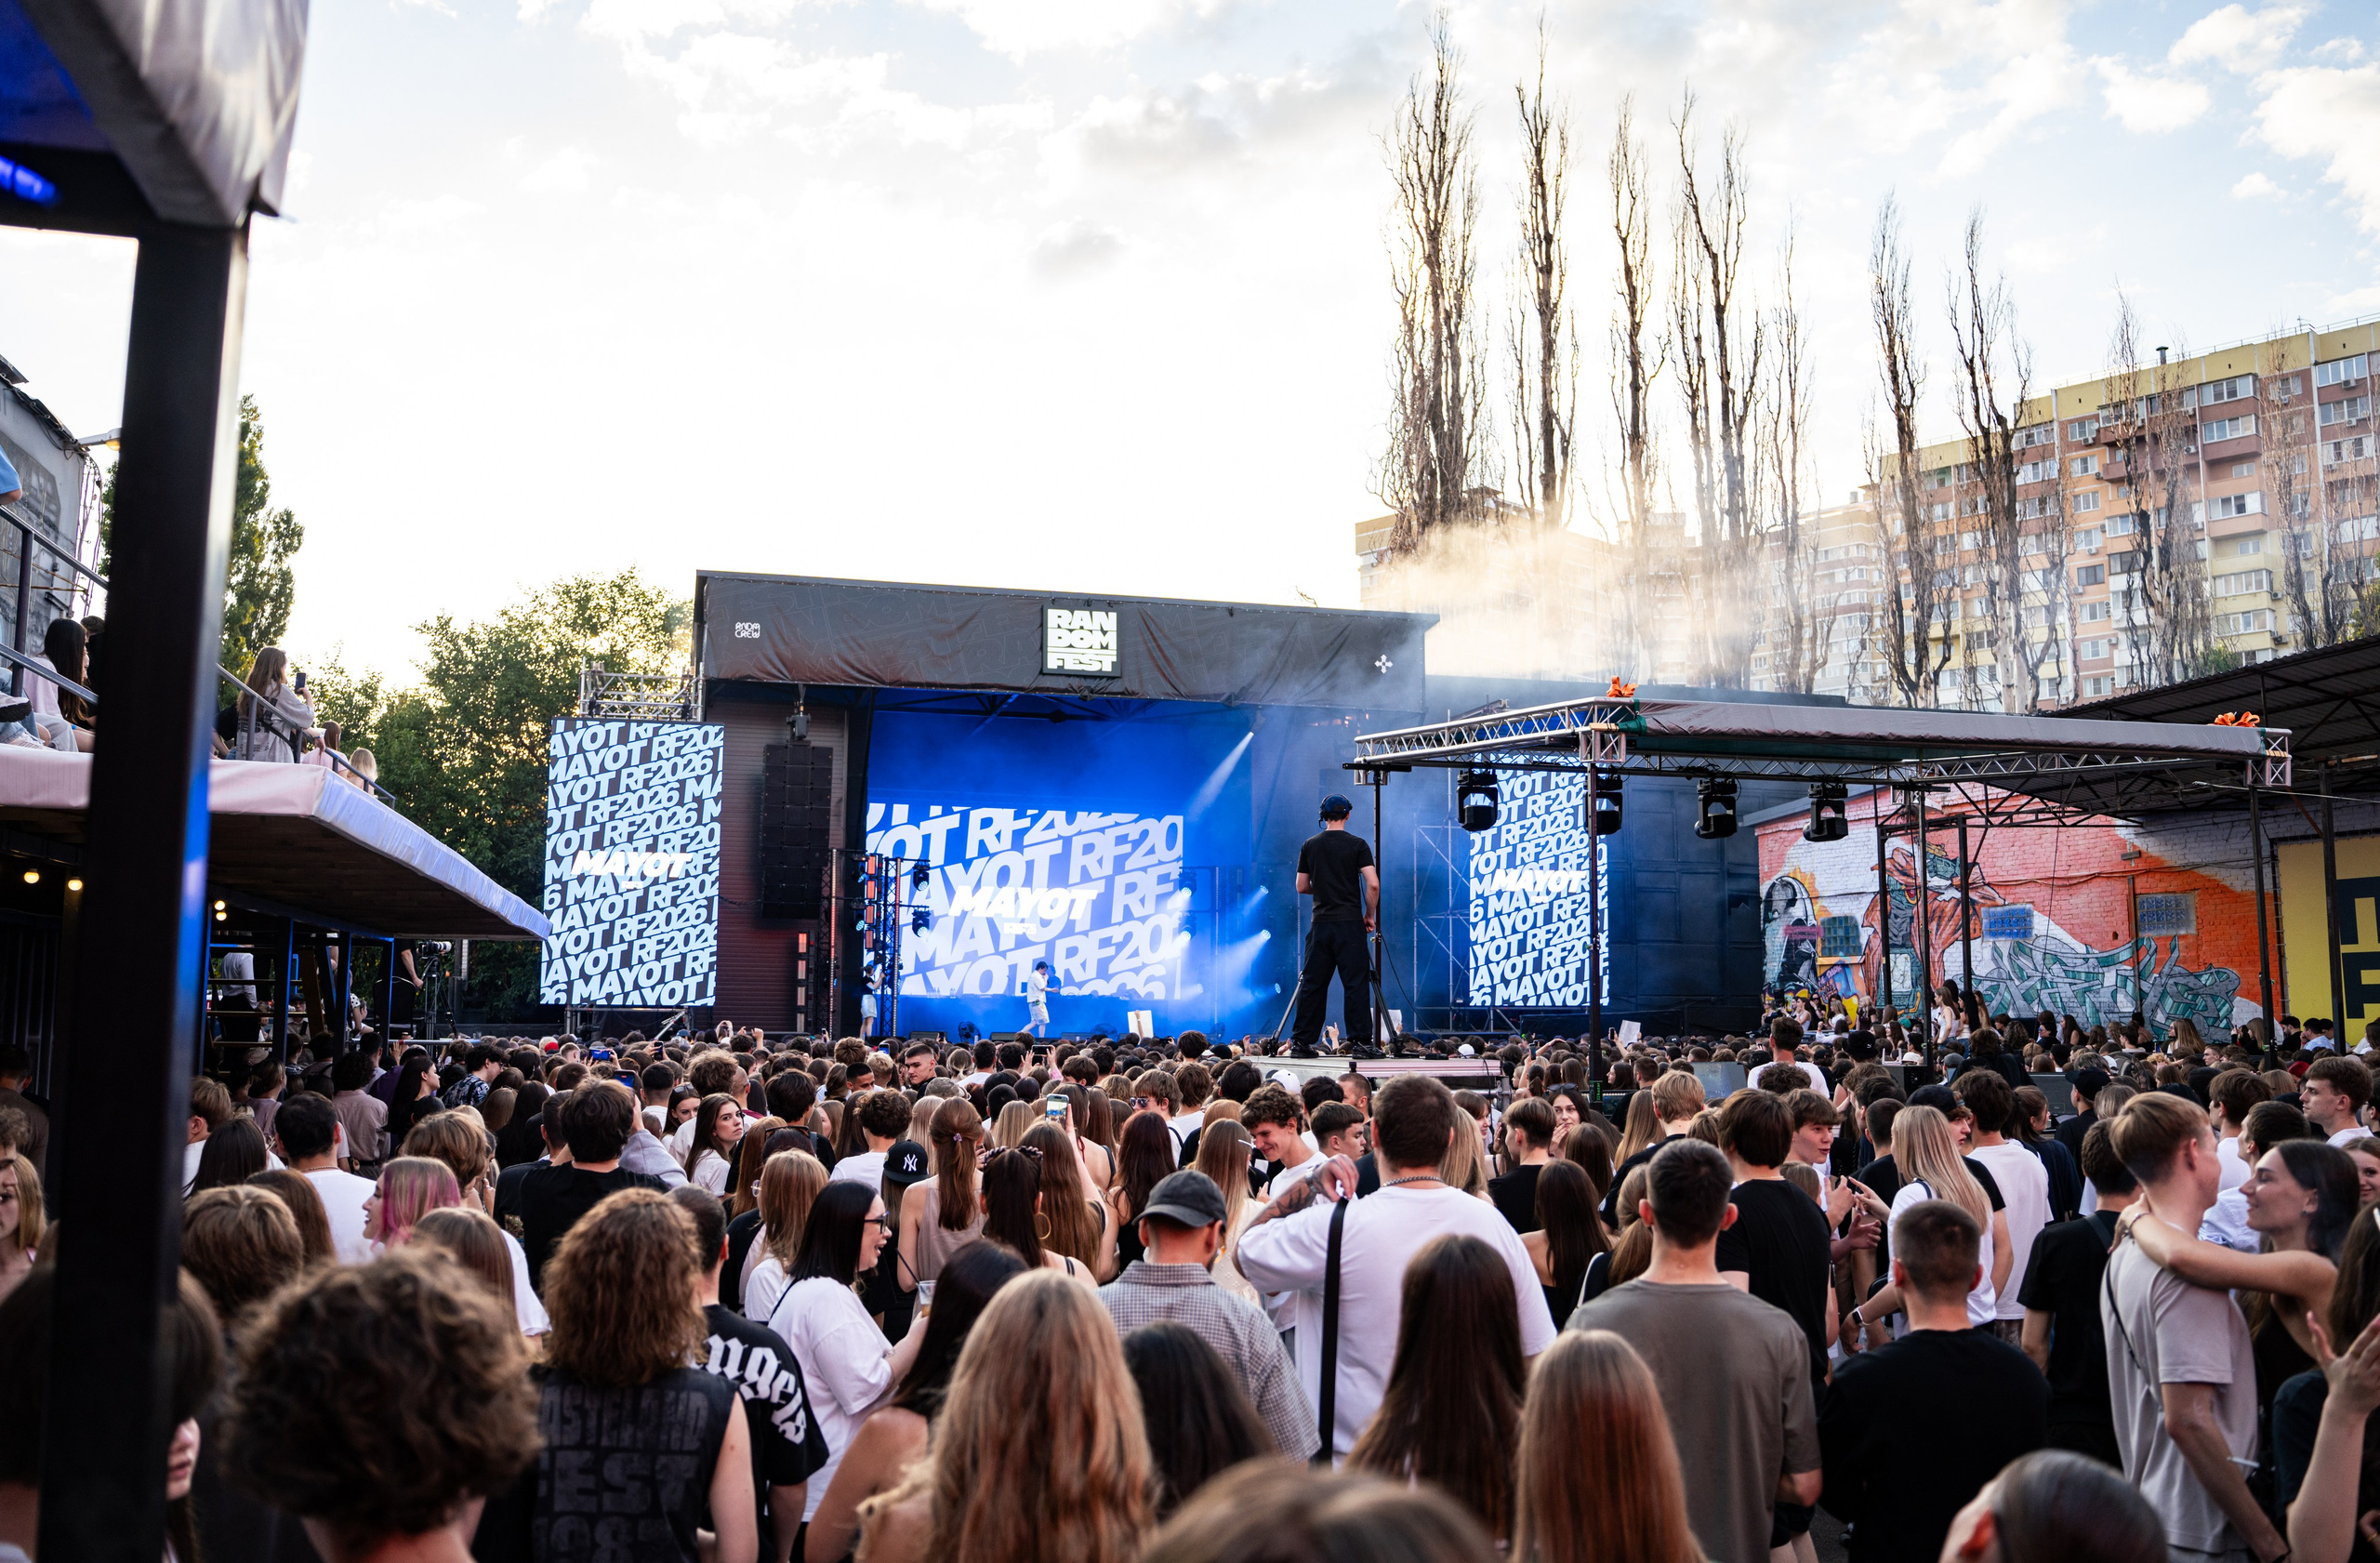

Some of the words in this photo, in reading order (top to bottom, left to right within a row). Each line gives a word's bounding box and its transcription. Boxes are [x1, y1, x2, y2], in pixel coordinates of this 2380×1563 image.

[735, 629, 760, 638] CREW
[1048, 609, 1117, 631] RAN
[1048, 628, 1117, 650] DOM
[1048, 652, 1117, 671] FEST
[619, 749, 714, 793] RF2026
[585, 782, 681, 826] RF2026
[603, 802, 699, 847] RF2026
[1501, 808, 1574, 847] RF2026
[570, 850, 694, 878] MAYOT
[1515, 827, 1589, 866] RF2026
[1490, 868, 1586, 893] MAYOT
[948, 885, 1098, 921] MAYOT
[542, 921, 610, 961] YOT
[613, 899, 707, 945] RF2026
[1526, 913, 1600, 952] RF202
[541, 942, 628, 987] AYOT
[572, 955, 681, 1004] MAYOT
[1470, 950, 1539, 991] AYOT
[1495, 960, 1580, 1006] MAYOT
[903, 1153, 919, 1172] NY
[689, 1333, 807, 1445] ngels
